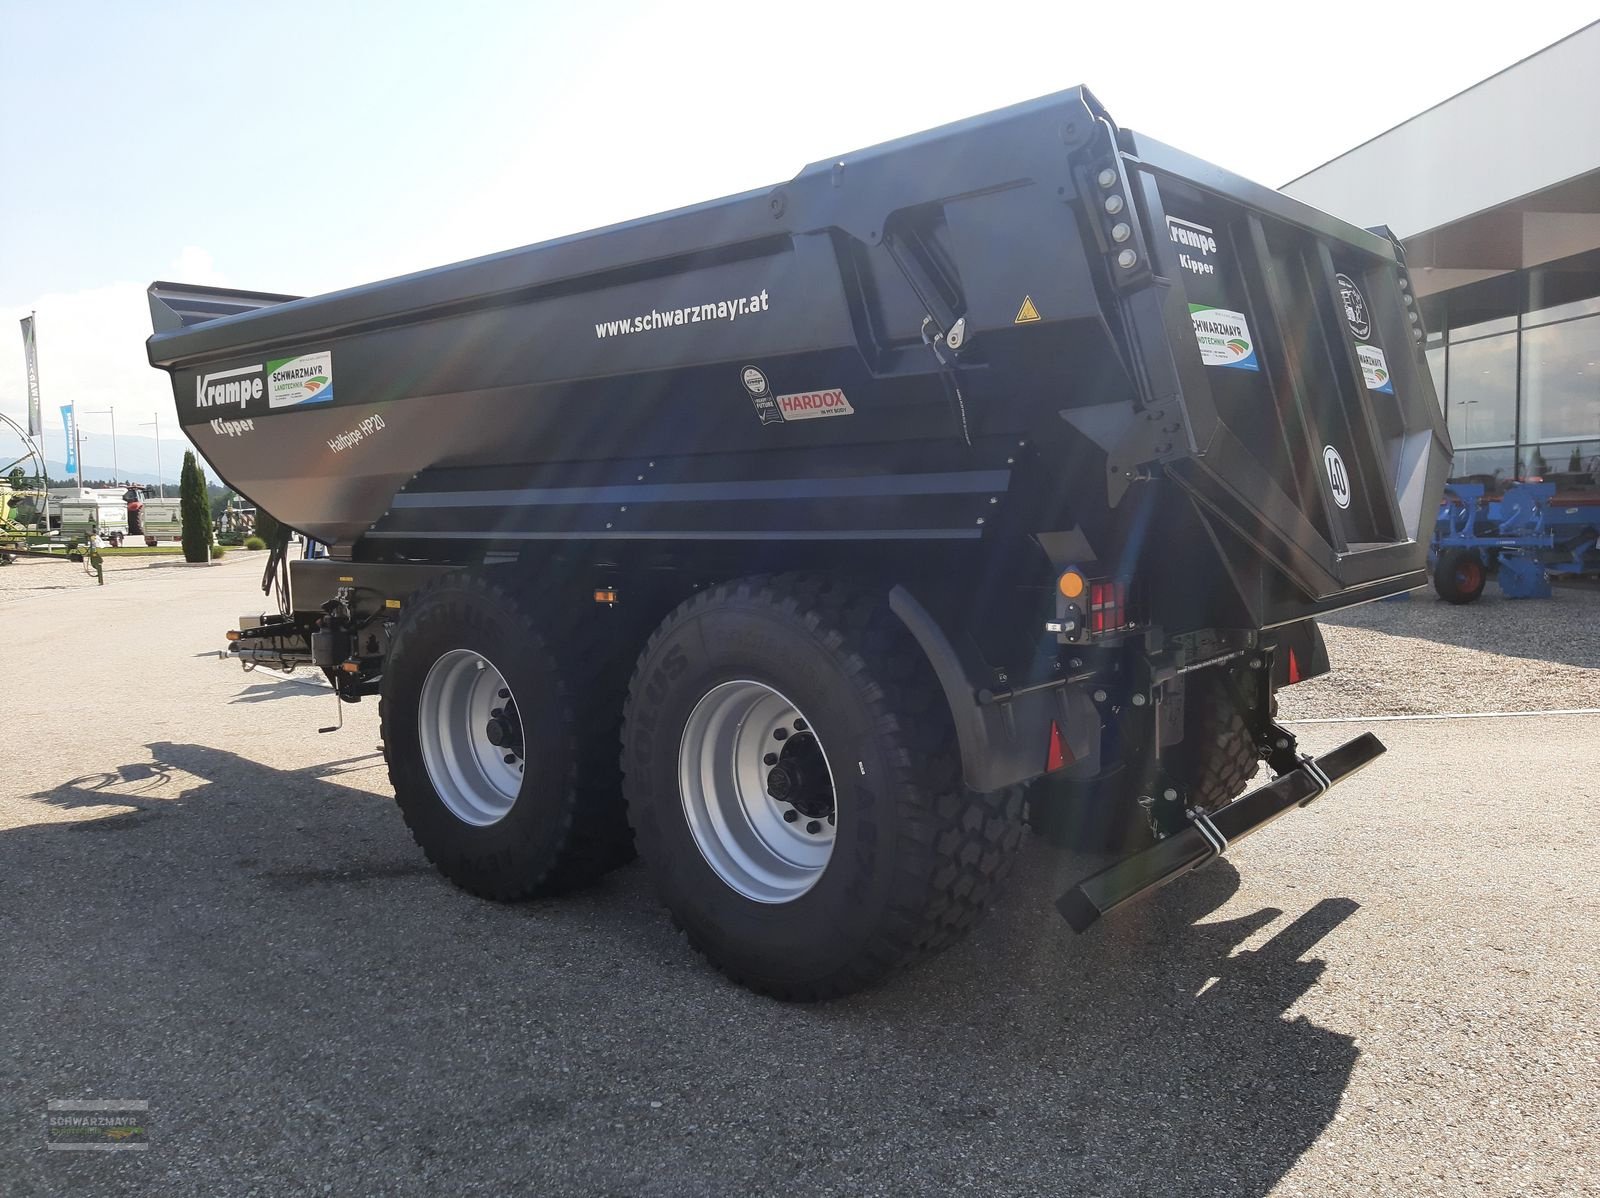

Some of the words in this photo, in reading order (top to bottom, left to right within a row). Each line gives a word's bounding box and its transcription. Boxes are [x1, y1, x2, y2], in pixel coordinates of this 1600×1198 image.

[1179, 254, 1213, 274] Kipper
[595, 289, 769, 339] www.schwarzmayr.at
[1192, 320, 1242, 338] CHWARZMAYR
[273, 365, 323, 382] SCHWARZMAYR
[196, 363, 263, 409] Krampe
[782, 391, 845, 412] HARDOX
[210, 417, 254, 437] Kipper
[327, 428, 363, 453] Halfpipe
[359, 414, 386, 436] HP20
[1328, 458, 1346, 495] 40
